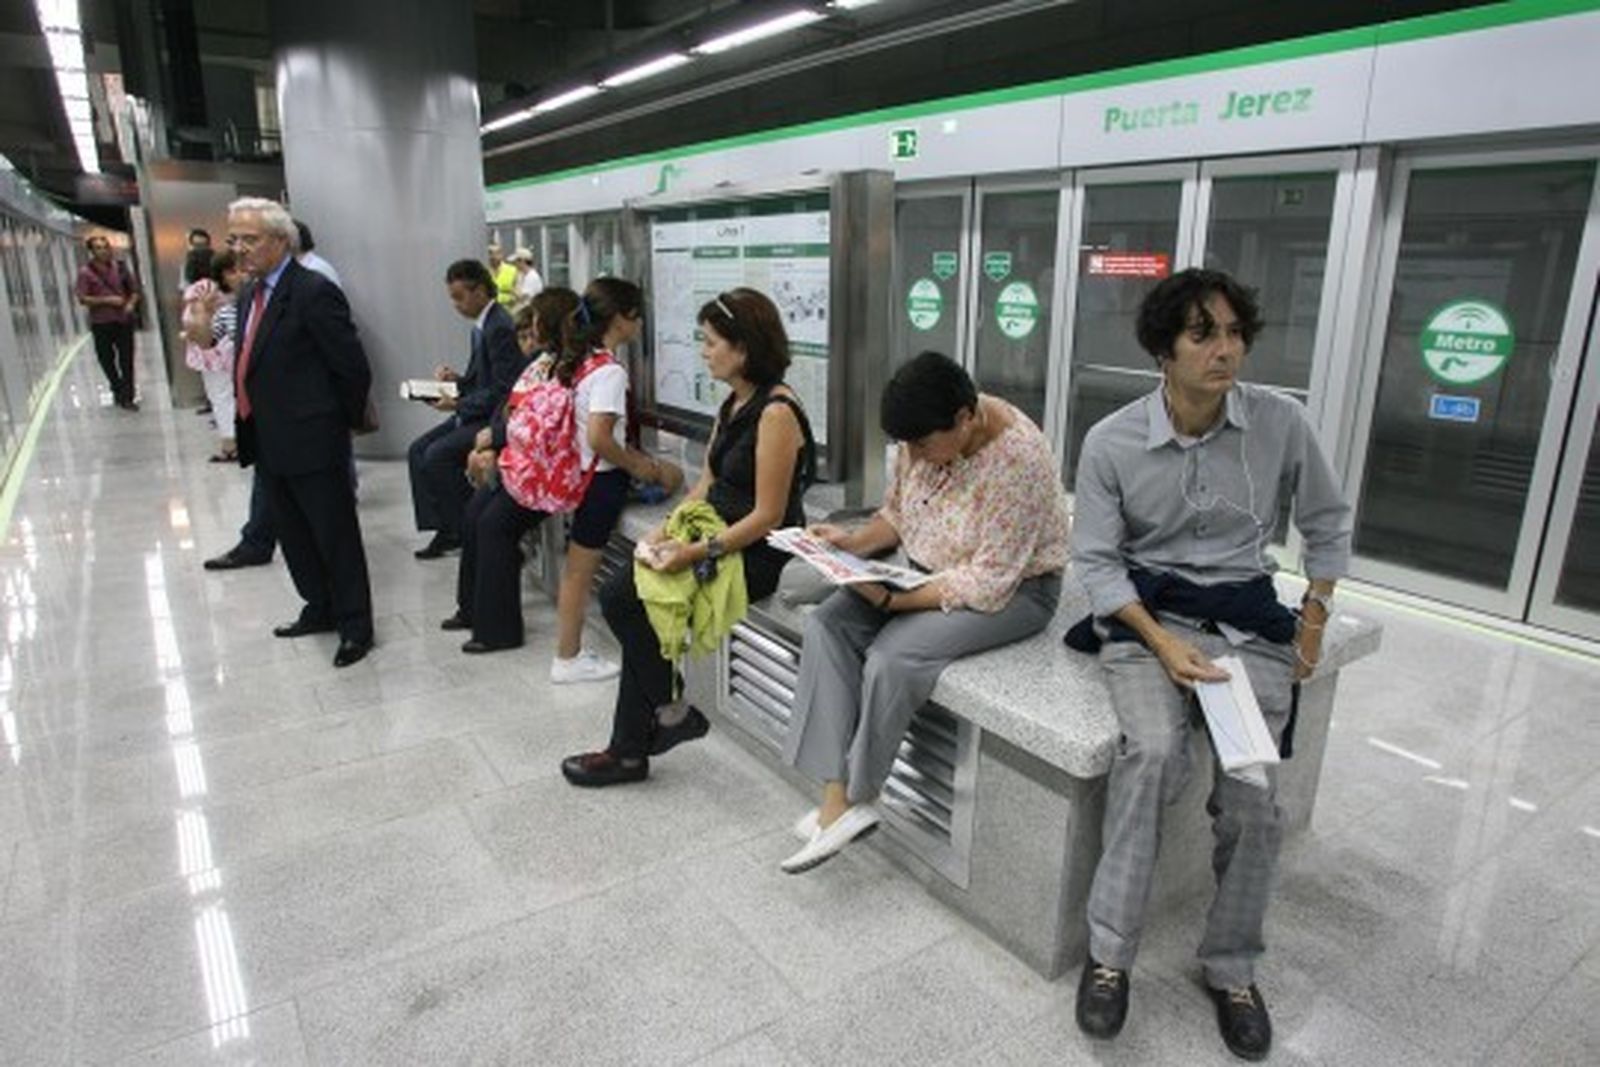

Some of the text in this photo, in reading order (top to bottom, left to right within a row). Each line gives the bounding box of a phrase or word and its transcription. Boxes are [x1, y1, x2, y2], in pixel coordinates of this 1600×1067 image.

[1104, 87, 1314, 133] Puerta Jerez
[1434, 333, 1497, 351] Metro
